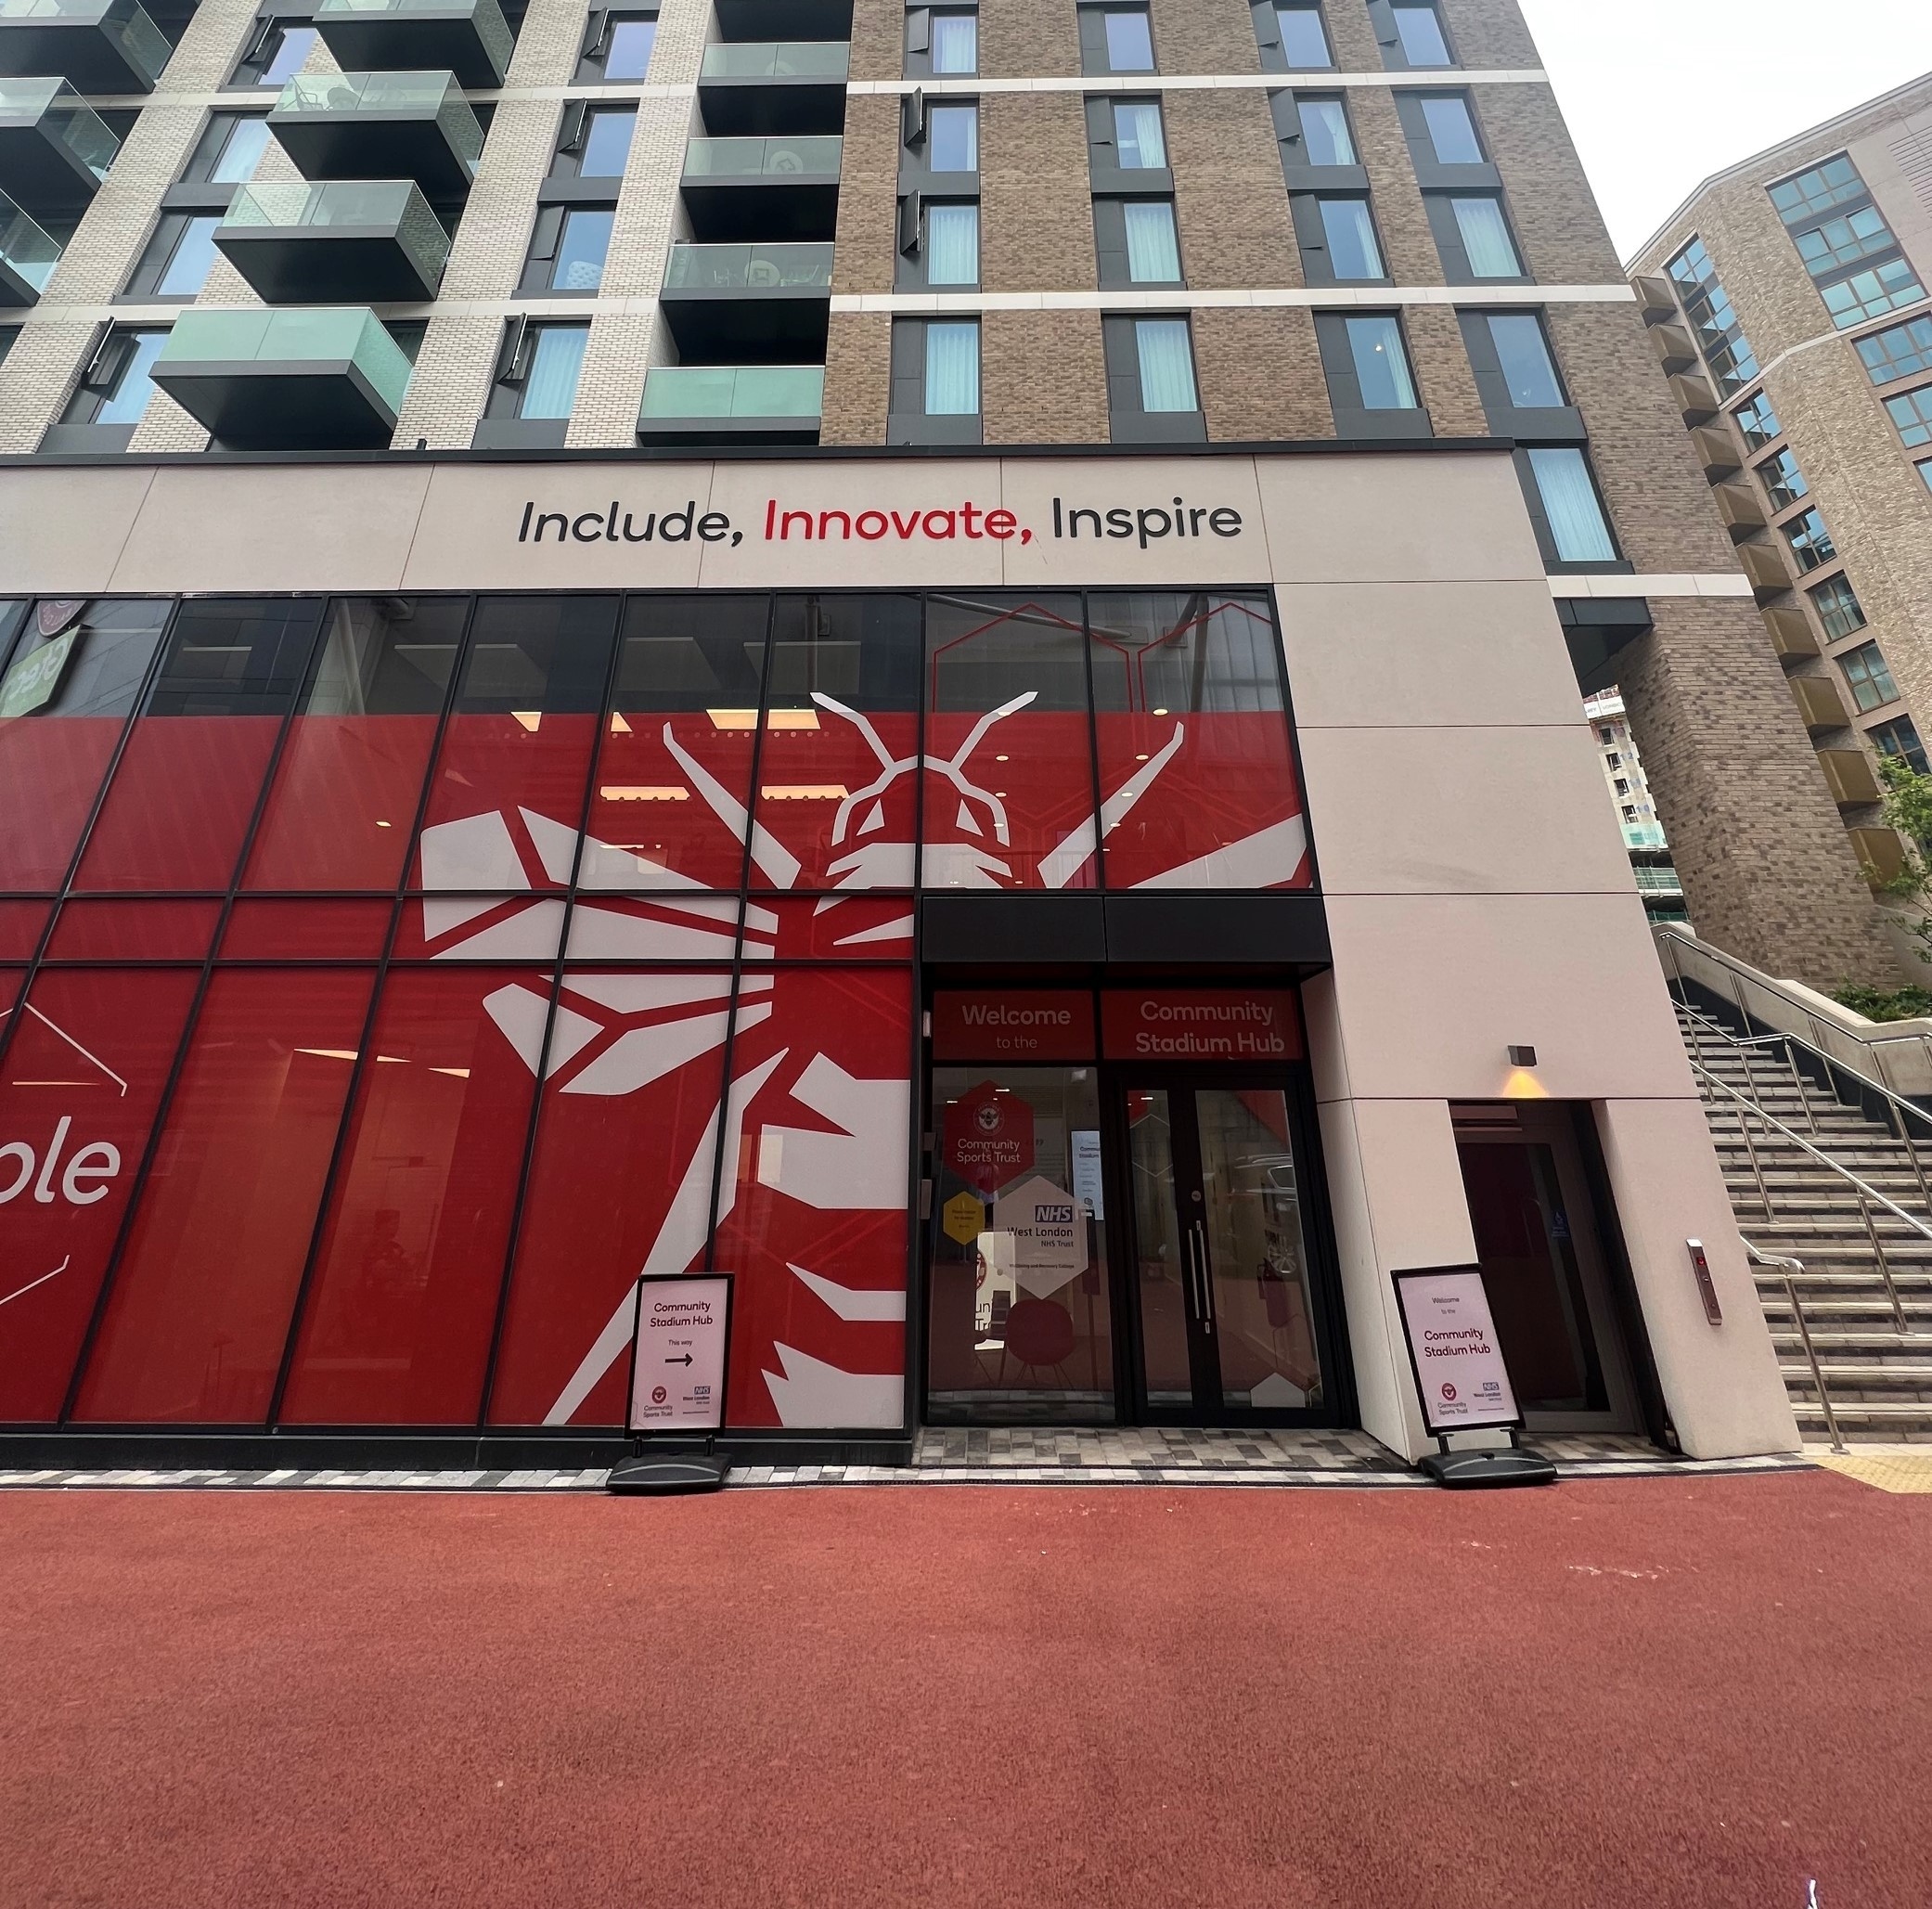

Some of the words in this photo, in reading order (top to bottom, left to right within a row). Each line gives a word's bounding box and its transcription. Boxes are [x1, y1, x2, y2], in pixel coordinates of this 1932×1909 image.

[518, 500, 744, 547] Include,
[764, 498, 1033, 546] Innovate,
[1052, 497, 1243, 549] Inspire
[961, 1003, 1071, 1026] Welcome
[1140, 1000, 1274, 1026] Community
[996, 1035, 1011, 1050] to
[1013, 1035, 1038, 1050] the
[1135, 1032, 1232, 1054] Stadium
[1237, 1031, 1286, 1053] Hub
[957, 1138, 1021, 1153] Community
[957, 1151, 993, 1166] Sports
[994, 1151, 1022, 1164] Trust
[1035, 1206, 1073, 1223] NHS
[1007, 1226, 1033, 1237] West
[1036, 1226, 1074, 1237] London
[1040, 1240, 1056, 1248] NHS
[1057, 1240, 1075, 1248] Trust
[654, 1301, 711, 1313] Community
[650, 1317, 690, 1327] Stadium
[693, 1315, 713, 1325] Hub
[1424, 1328, 1483, 1340] Community
[1424, 1346, 1468, 1358] Stadium
[1469, 1344, 1491, 1354] Hub
